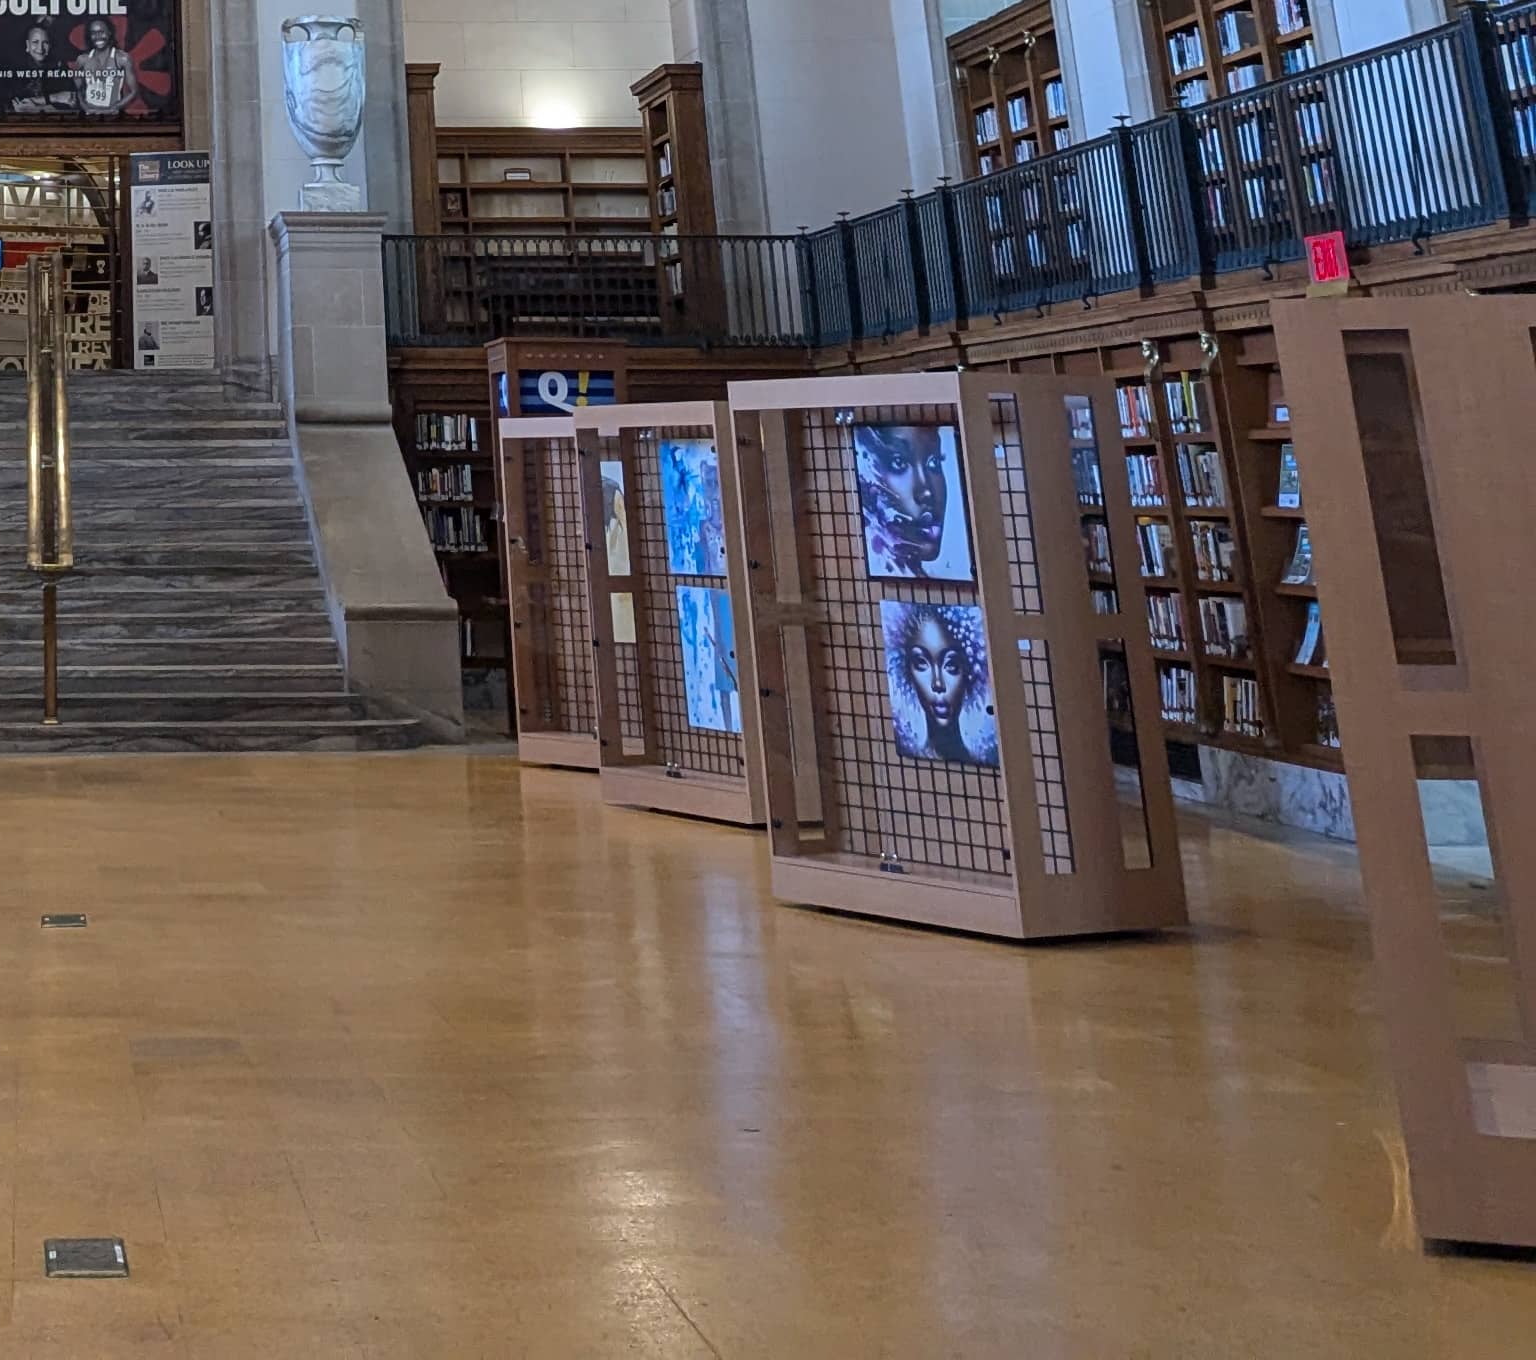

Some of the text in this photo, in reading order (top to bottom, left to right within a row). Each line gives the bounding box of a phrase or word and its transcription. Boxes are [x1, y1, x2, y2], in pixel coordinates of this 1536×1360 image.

[16, 70, 44, 78] WEST
[47, 70, 92, 78] READING
[167, 160, 210, 169] LOOK UP
